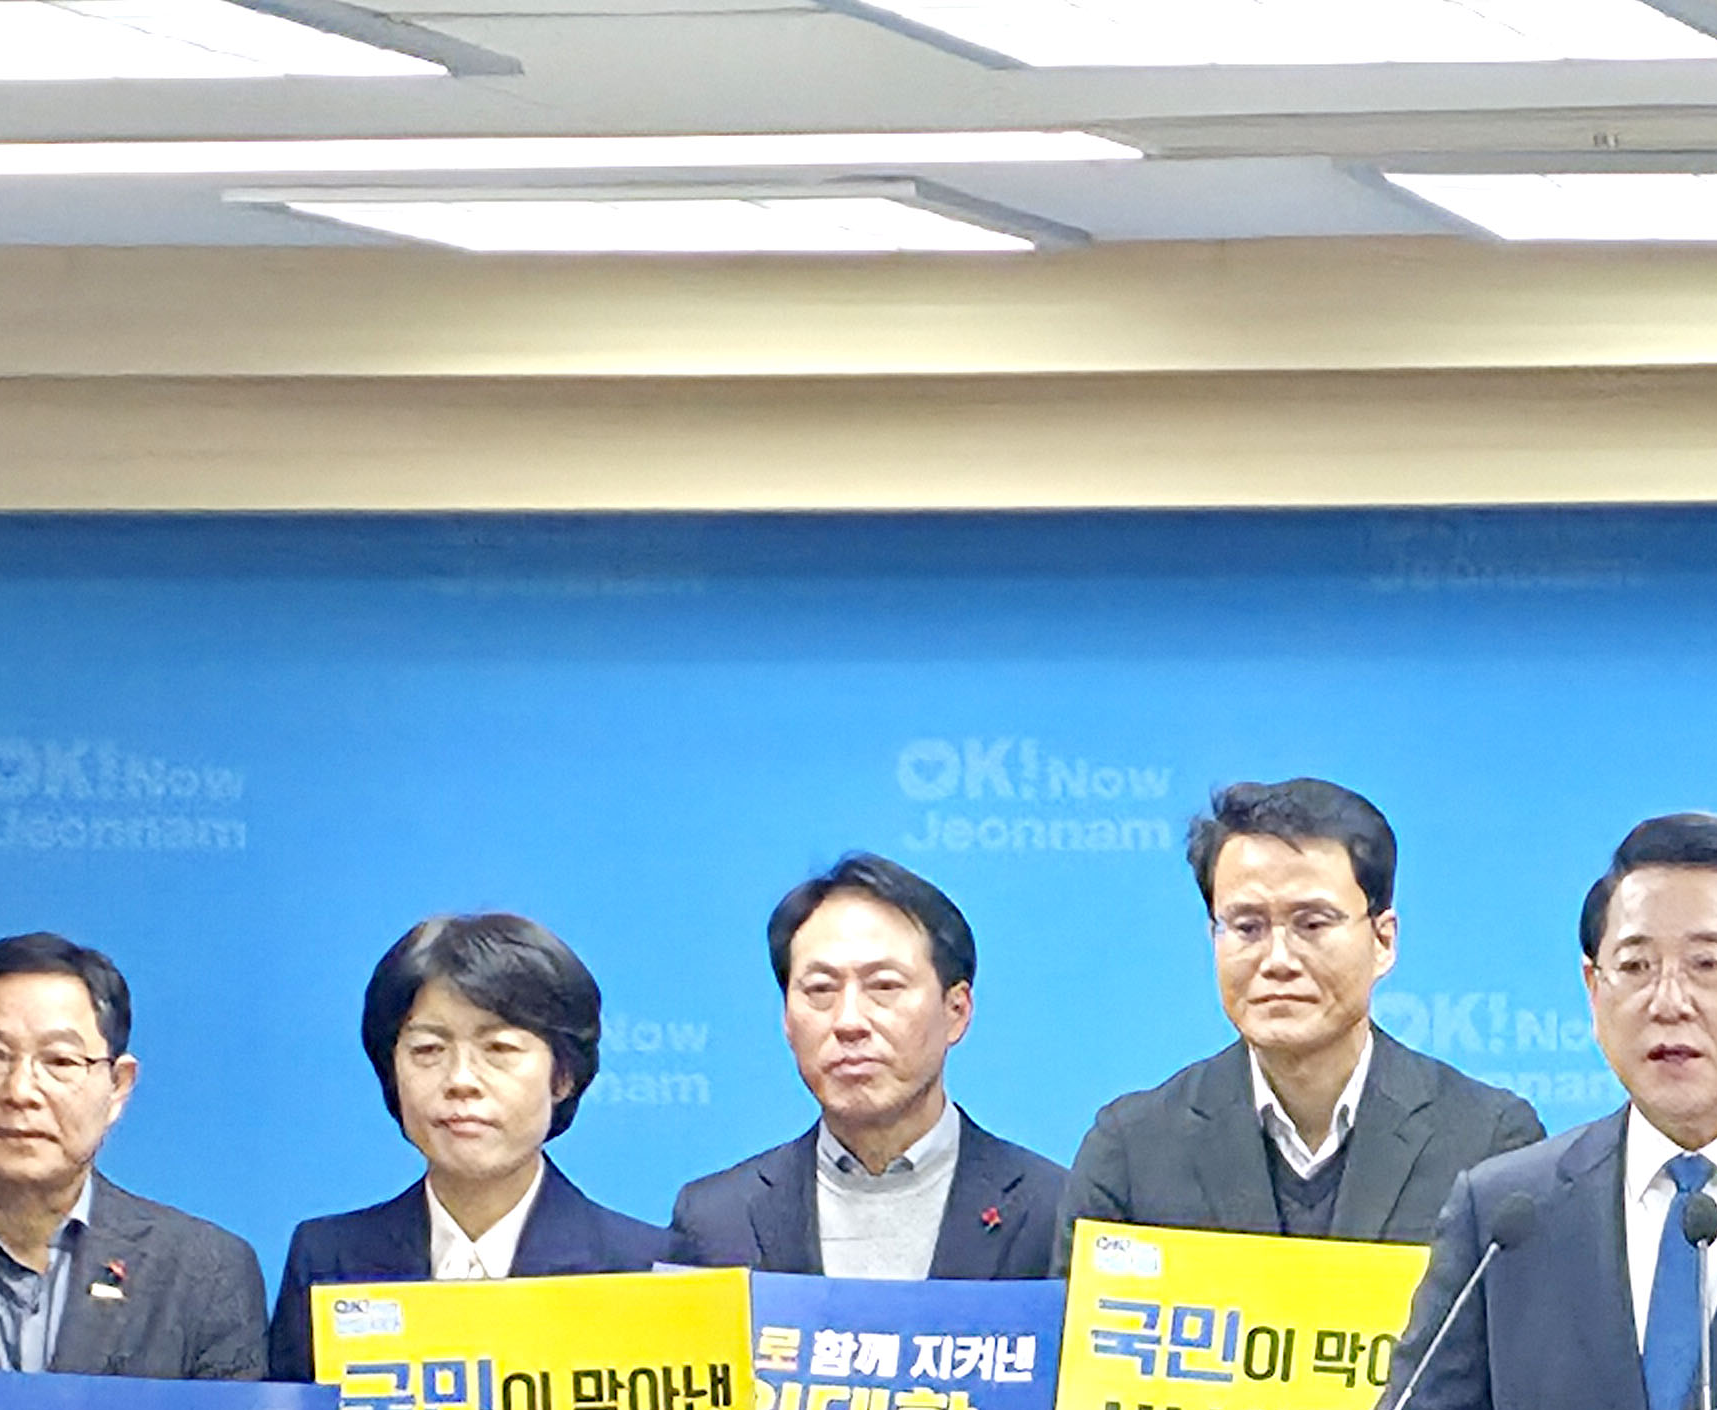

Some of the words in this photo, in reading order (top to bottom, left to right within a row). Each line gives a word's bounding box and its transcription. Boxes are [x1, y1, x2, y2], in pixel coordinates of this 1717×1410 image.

[898, 737, 1039, 800] OK!
[1047, 756, 1173, 798] Now
[902, 808, 1171, 850] Jeonnam
[1514, 1008, 1591, 1051] No
[810, 1329, 900, 1378] 함께
[910, 1333, 1037, 1383] 지켜낸
[1091, 1298, 1295, 1383] 국민이
